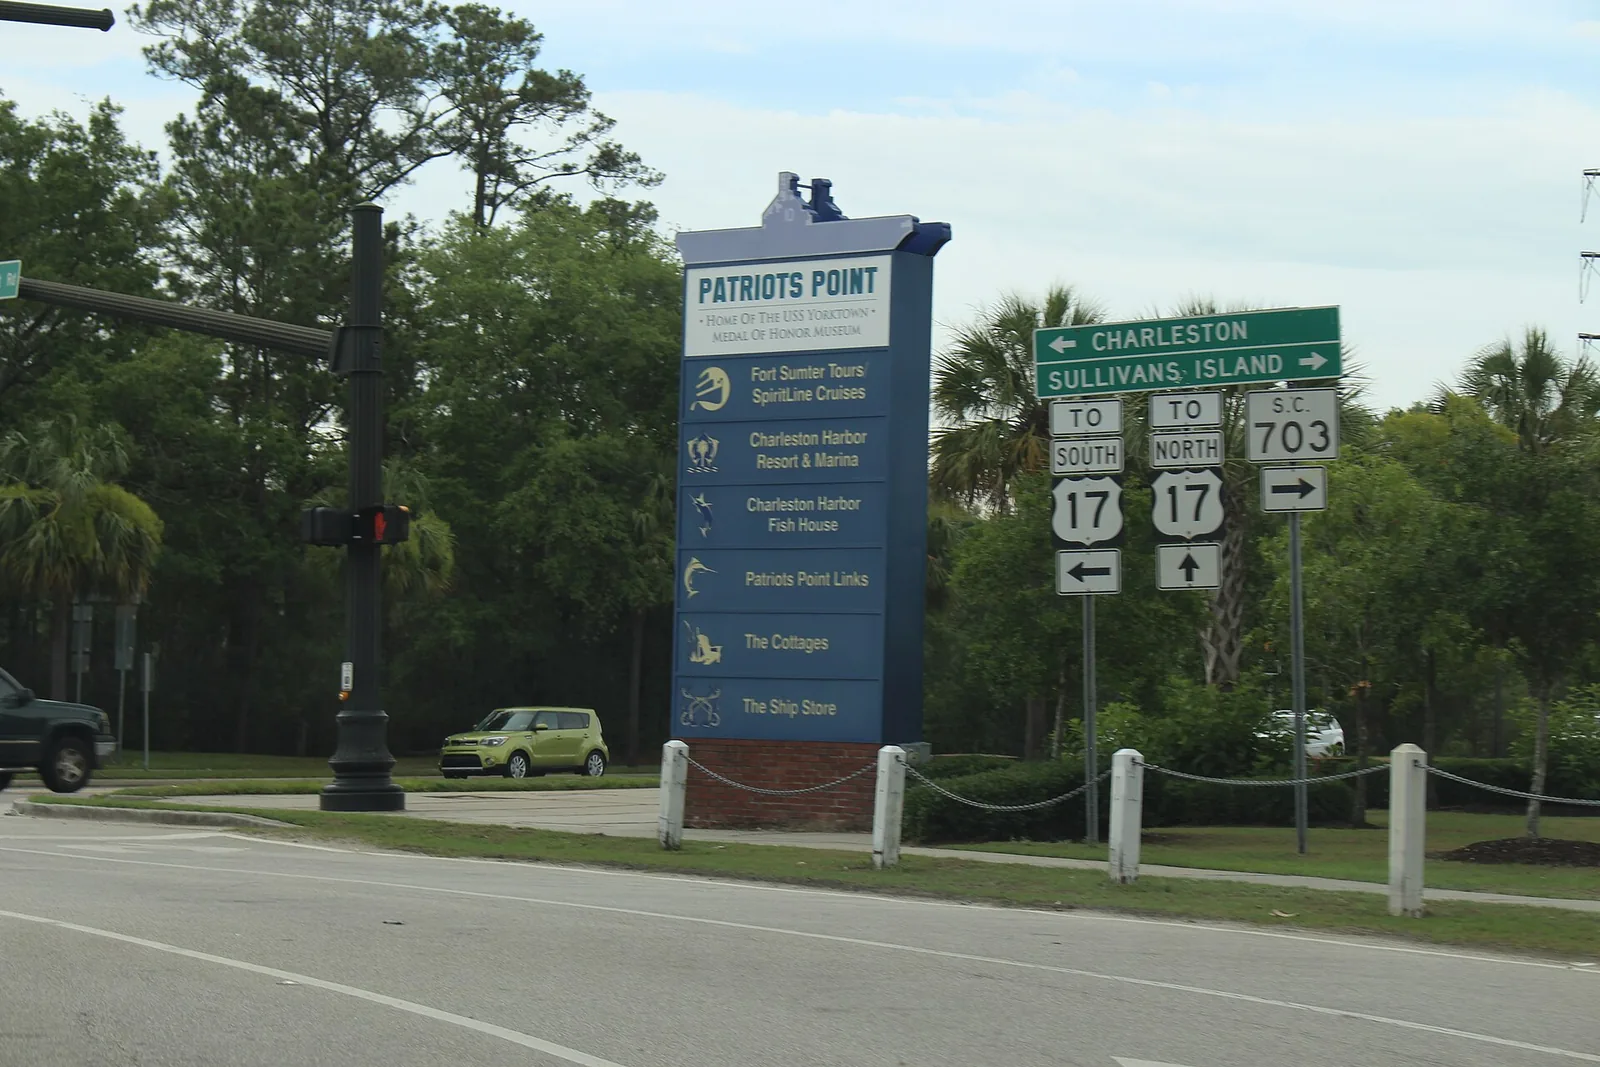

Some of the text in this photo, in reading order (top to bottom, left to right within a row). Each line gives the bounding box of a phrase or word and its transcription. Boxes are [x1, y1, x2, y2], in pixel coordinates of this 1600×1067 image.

[699, 267, 878, 303] PATRIOTS POINT
[783, 309, 804, 322] USS
[1092, 320, 1248, 351] CHARLESTON
[751, 366, 776, 381] Fort
[779, 365, 825, 381] Sumter
[1048, 354, 1283, 391] SULLIVANS ISLAND
[752, 385, 866, 407] SpiritLine Cruises
[1272, 397, 1310, 413] S.C.
[1069, 408, 1101, 428] TO
[1169, 400, 1201, 420] TO
[749, 429, 867, 448] Charleston Harbor
[1254, 420, 1330, 454] 703
[1056, 446, 1117, 467] SOUTH
[1155, 439, 1218, 460] NORTH
[757, 452, 859, 469] Resort & Marina
[746, 496, 862, 513] Charleston Harbor
[1067, 491, 1109, 529] 17
[1167, 484, 1210, 523] 17
[768, 517, 839, 532] Fish House
[745, 571, 869, 587] Patriots Point Links
[744, 633, 829, 654] The Cottages
[743, 698, 837, 719] The Ship Store
